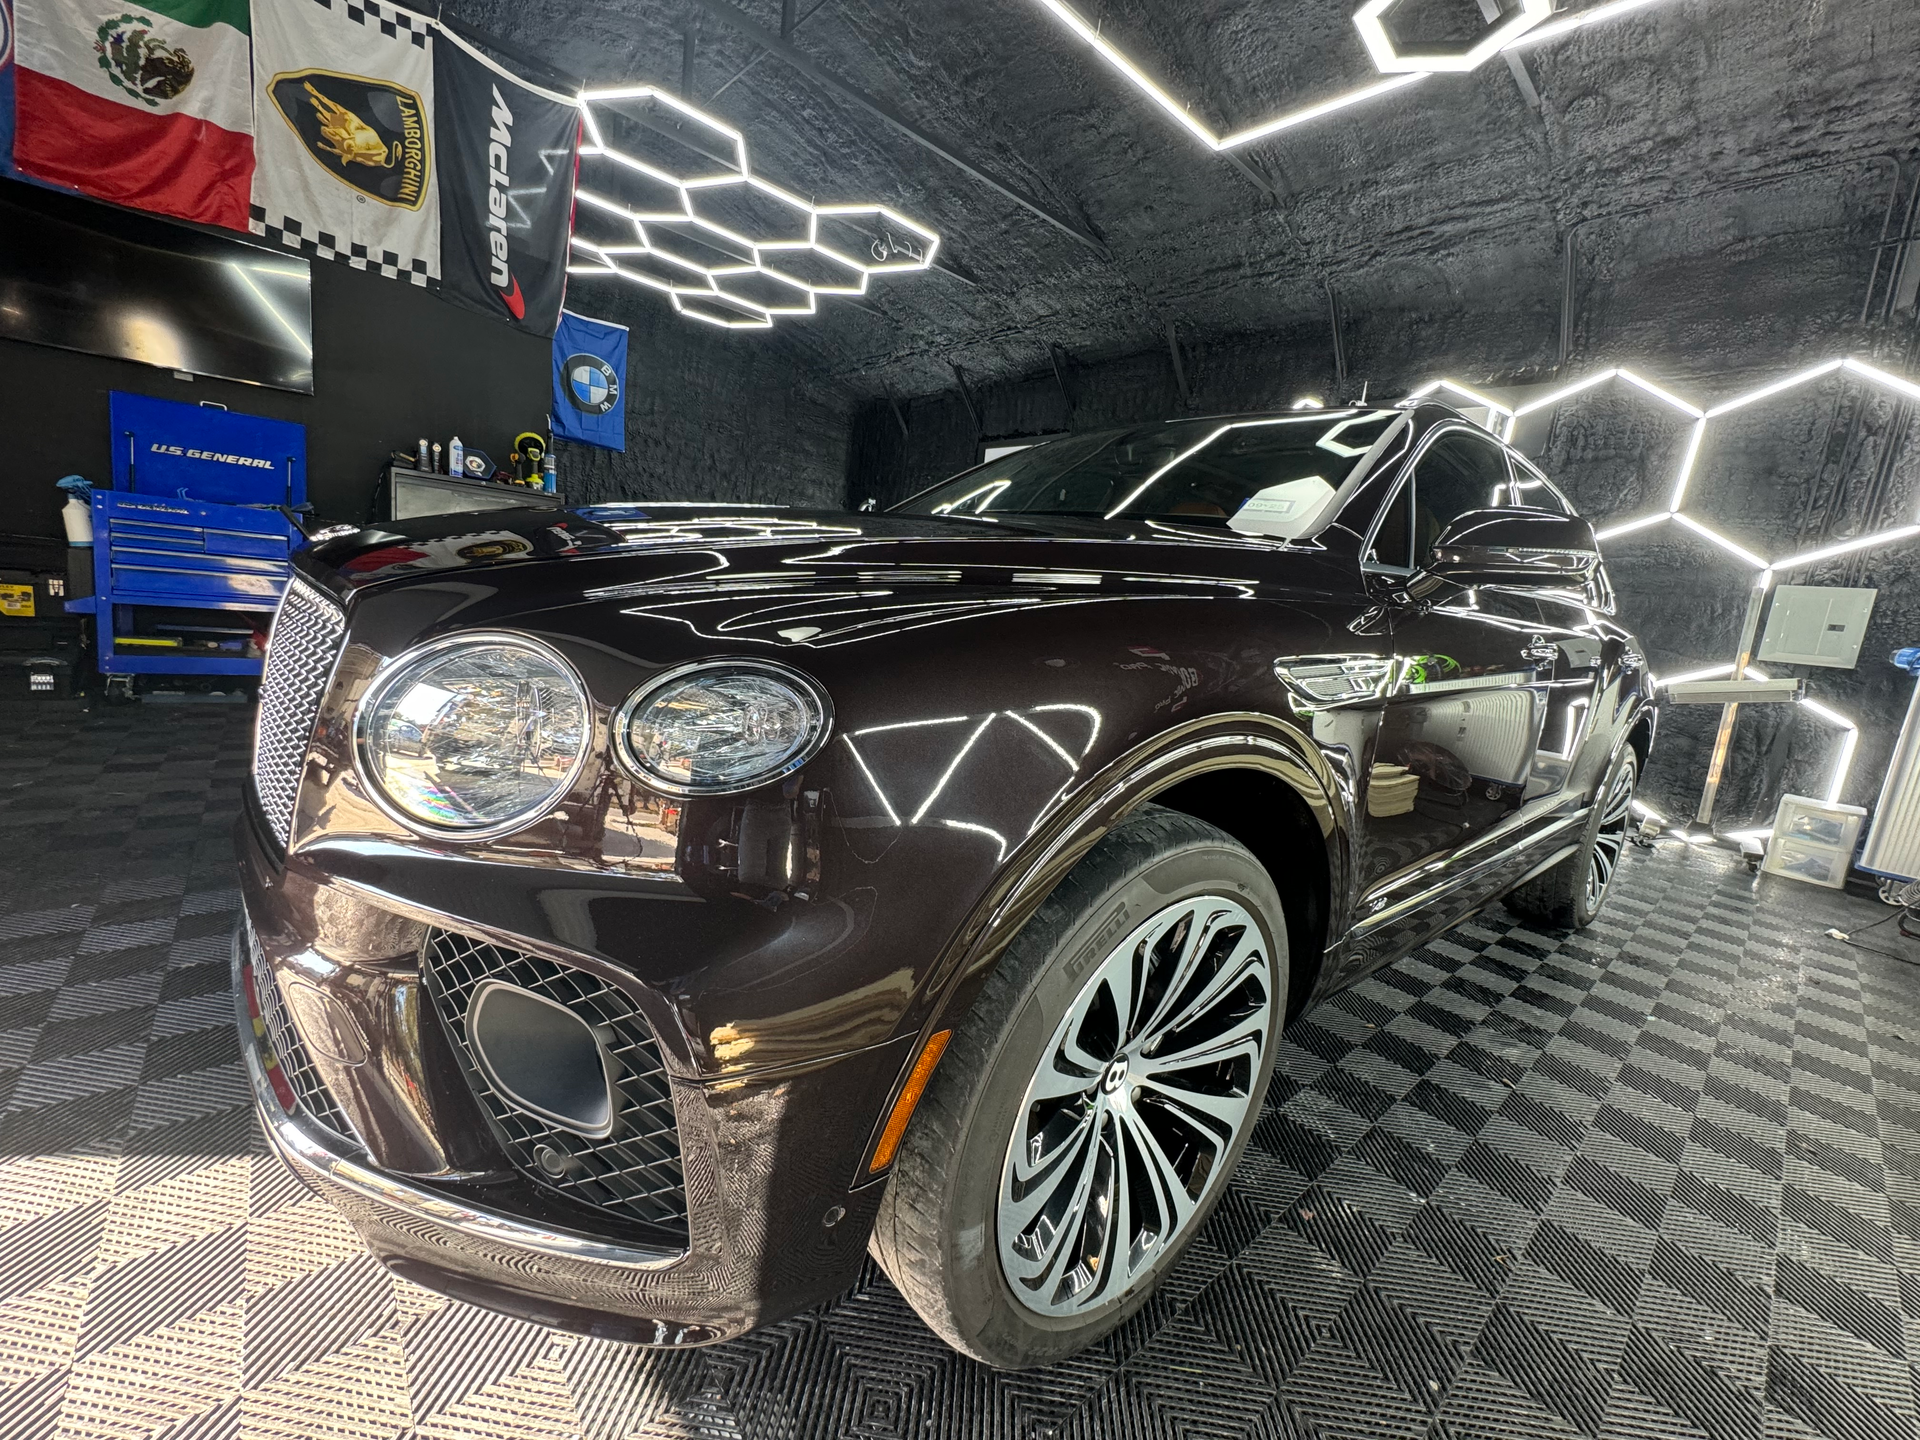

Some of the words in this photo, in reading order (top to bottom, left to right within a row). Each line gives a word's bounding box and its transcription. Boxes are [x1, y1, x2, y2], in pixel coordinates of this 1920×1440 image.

[396, 95, 421, 201] LAMBORGHINI
[489, 83, 513, 288] McLaren
[600, 364, 618, 412] BMW
[151, 443, 184, 456] U.S.
[186, 449, 275, 470] GENERAL
[1062, 901, 1130, 983] PIRELLI
